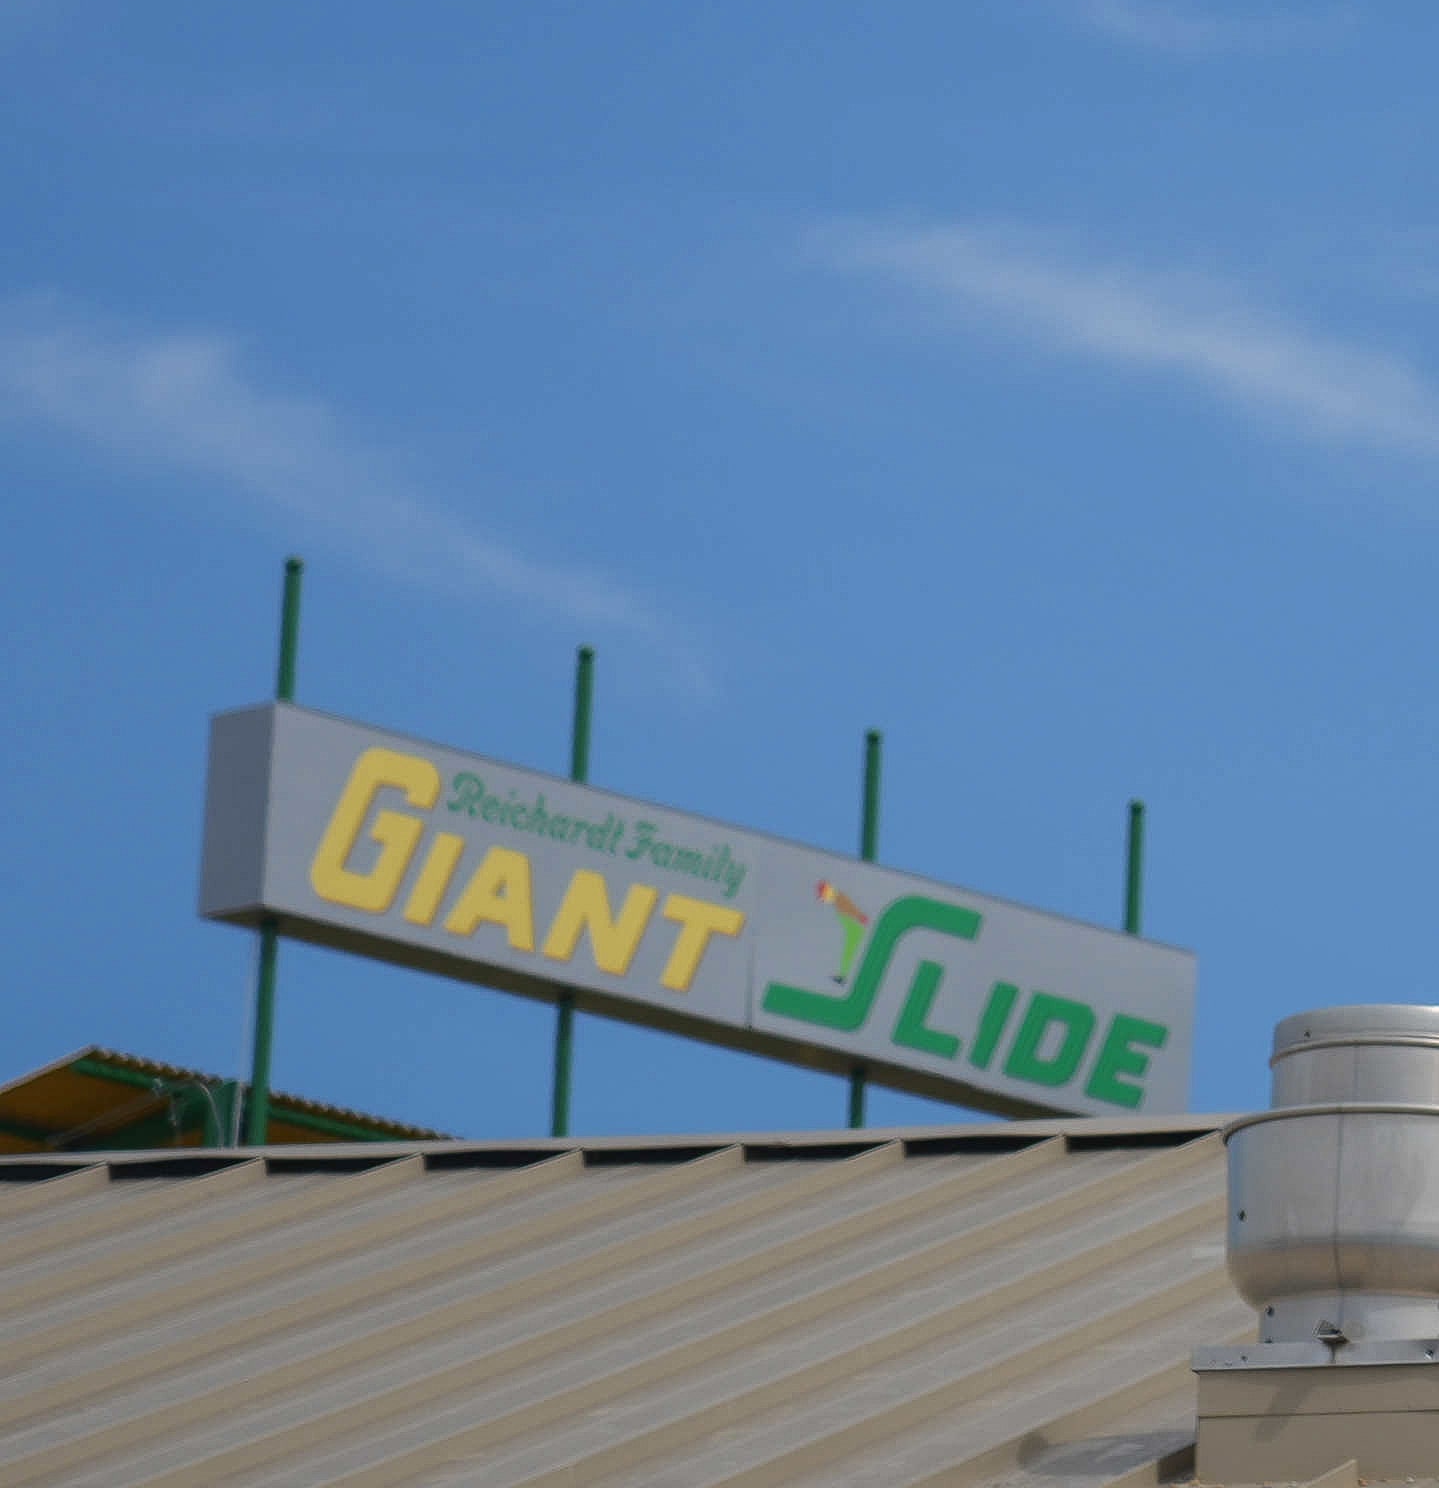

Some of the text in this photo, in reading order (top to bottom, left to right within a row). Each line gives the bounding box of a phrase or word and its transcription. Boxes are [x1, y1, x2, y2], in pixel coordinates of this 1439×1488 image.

[308, 747, 1169, 1109] GIANT SLIDE
[447, 770, 748, 900] Reichardt Family
